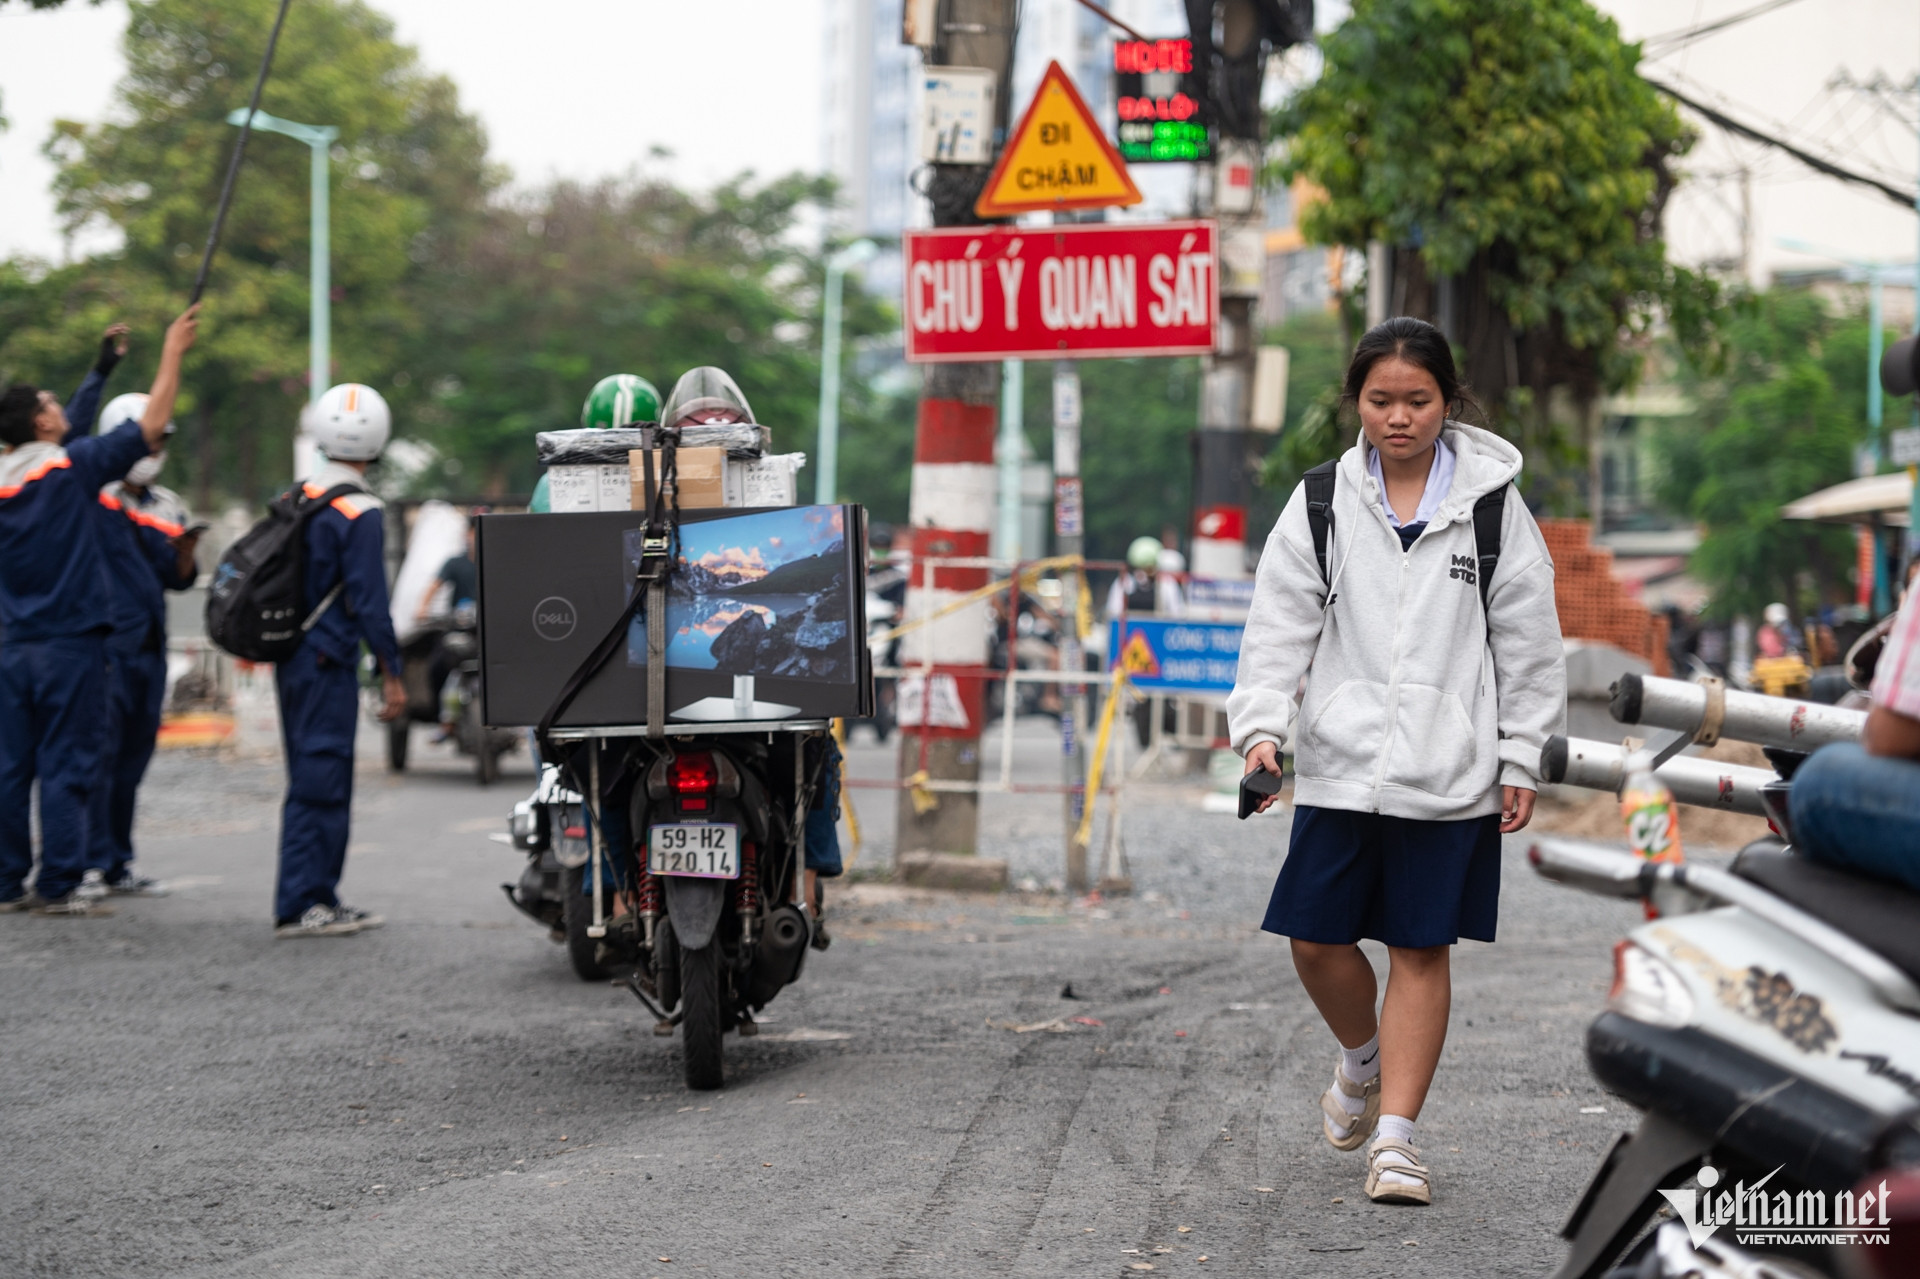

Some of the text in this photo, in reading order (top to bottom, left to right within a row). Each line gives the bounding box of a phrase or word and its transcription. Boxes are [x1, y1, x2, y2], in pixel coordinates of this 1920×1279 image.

[1040, 121, 1072, 146] ĐI
[911, 232, 1213, 333] CHÚ Ý QUAN SÁT
[538, 612, 572, 625] DELL
[662, 828, 725, 849] 59-H2
[1630, 810, 1670, 850] C2
[657, 851, 731, 874] 120.14
